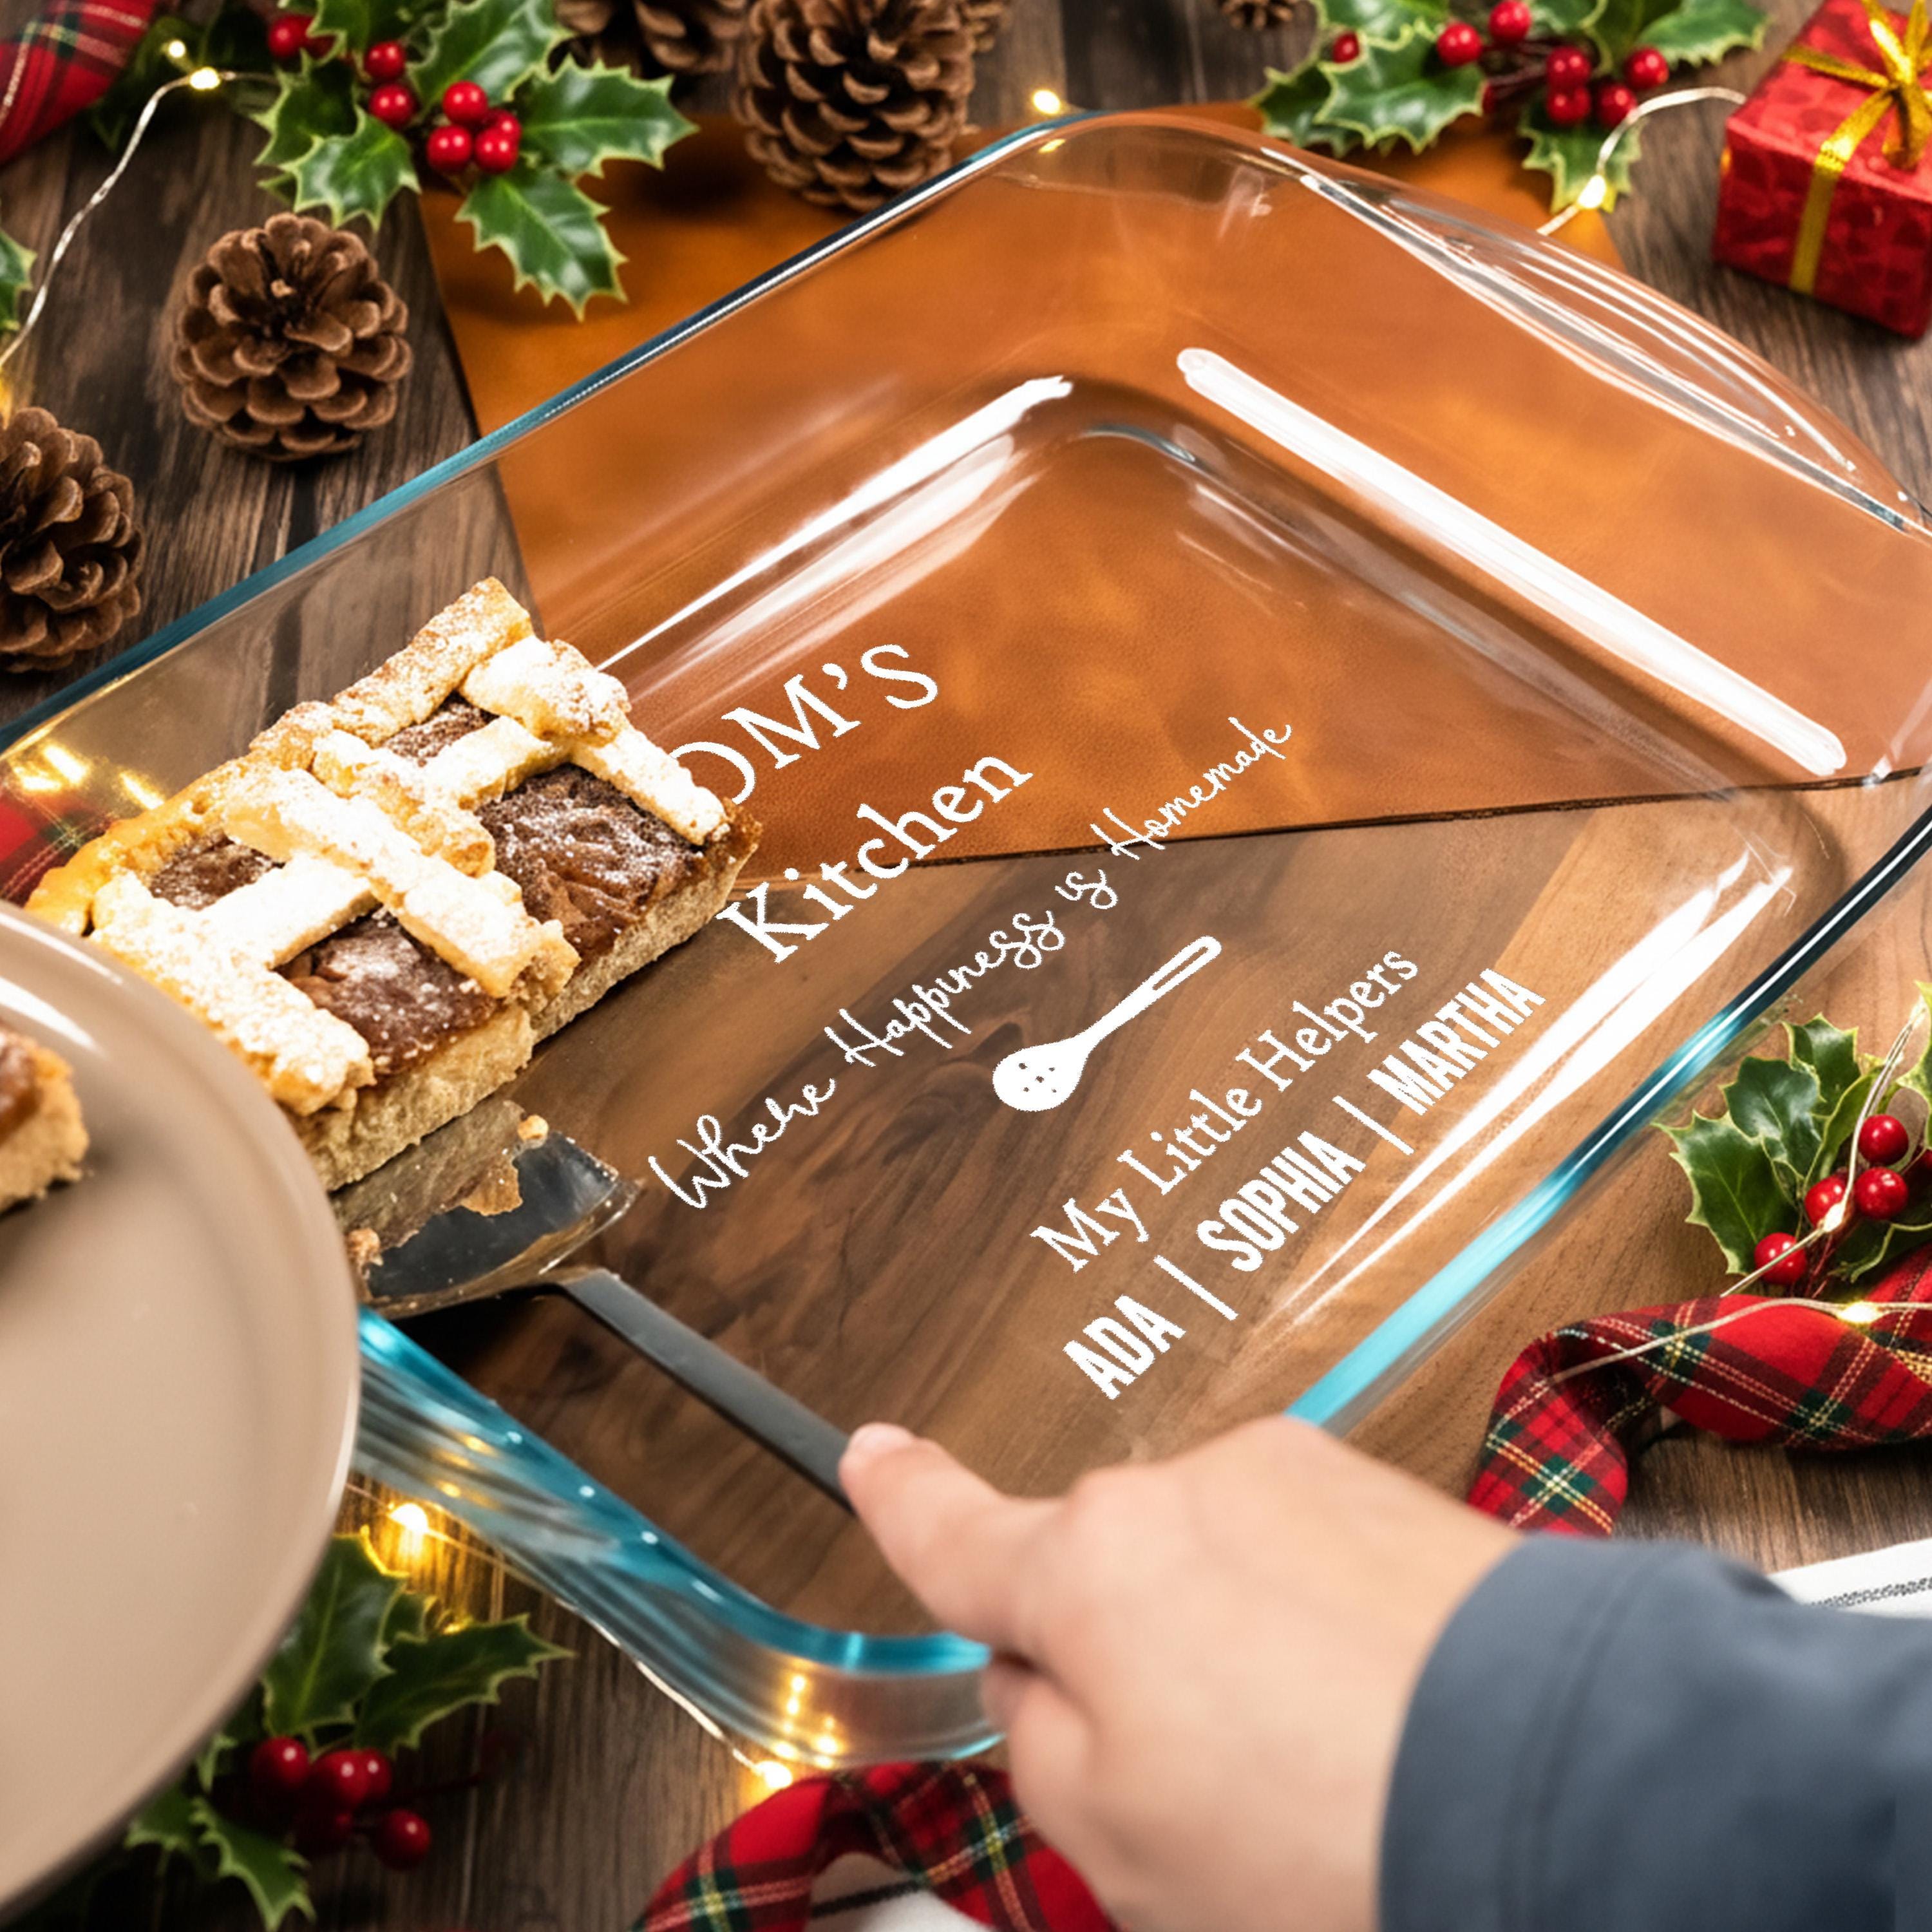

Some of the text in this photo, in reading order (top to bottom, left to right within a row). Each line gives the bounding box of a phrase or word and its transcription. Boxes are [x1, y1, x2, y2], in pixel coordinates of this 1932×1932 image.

[668, 644, 938, 805] OM'S
[716, 755, 1034, 963] Kitchen
[649, 717, 1292, 1209] Where Happiness is Homemade
[1030, 951, 1418, 1273] My Little Helpers
[1063, 1294, 1186, 1401] ADA
[1197, 1130, 1366, 1273] SOPHIA
[1366, 968, 1547, 1116] MARTHA
